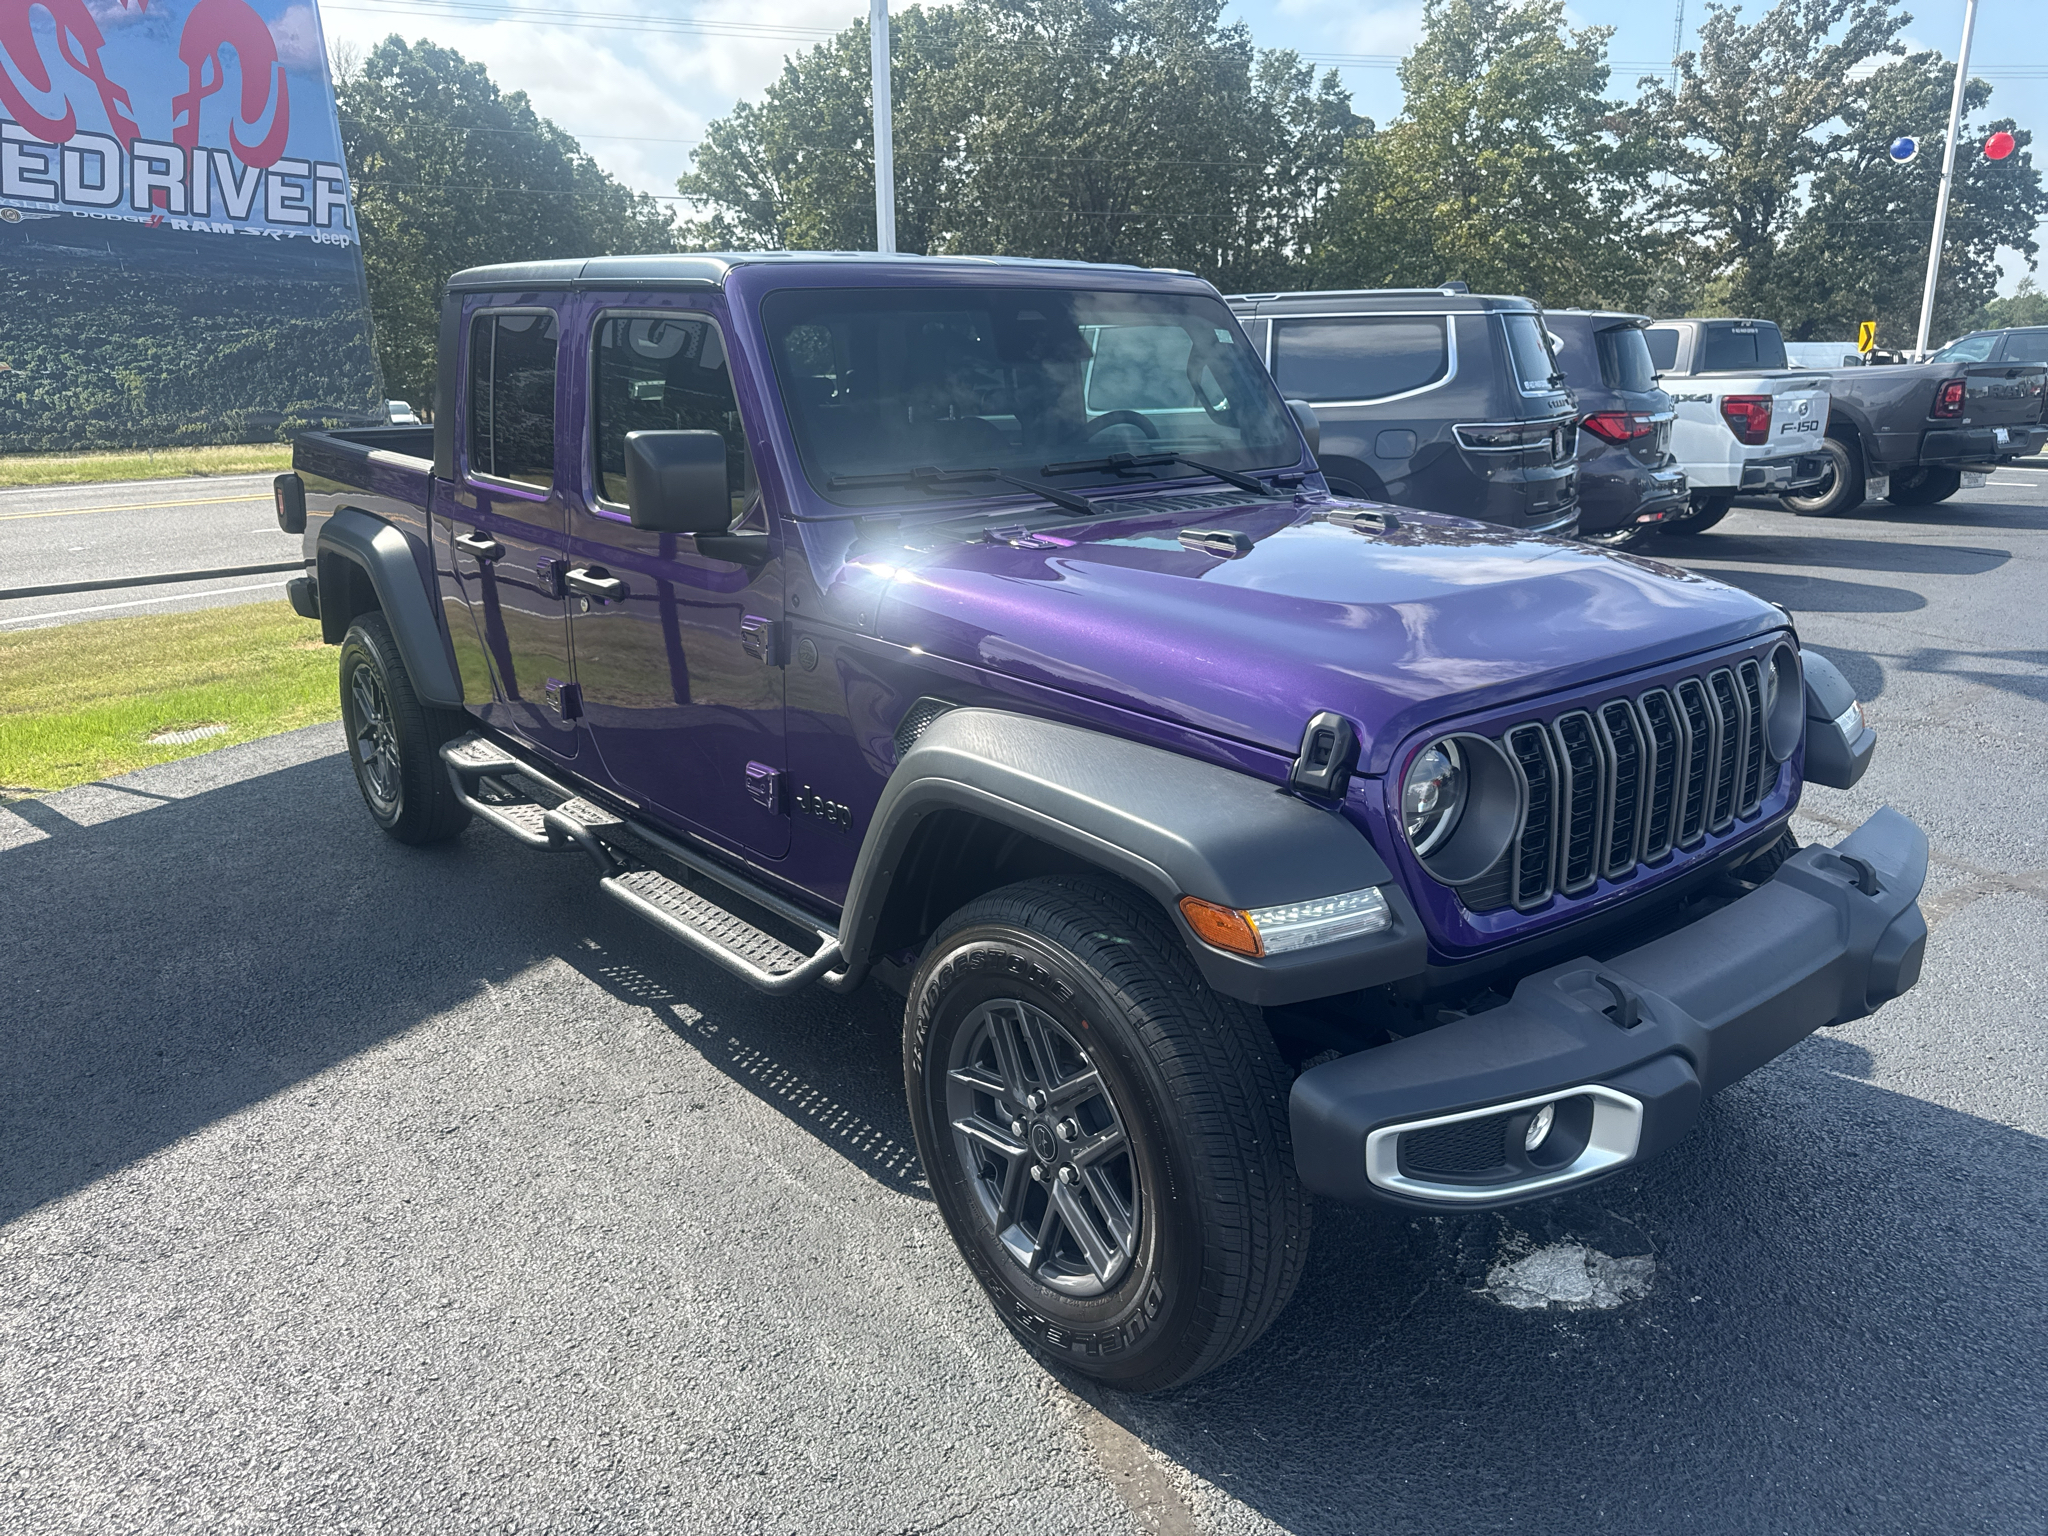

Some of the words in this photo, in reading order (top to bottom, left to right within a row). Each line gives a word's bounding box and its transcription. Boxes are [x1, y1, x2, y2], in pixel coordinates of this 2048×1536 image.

[72, 210, 154, 224] DODGE
[170, 218, 235, 235] RAM
[240, 227, 303, 241] SRT
[311, 228, 350, 249] Jeep
[1780, 420, 1819, 435] F-150
[796, 784, 853, 834] Jeep
[912, 948, 1075, 1077] BRIDGESTONE
[1014, 1277, 1164, 1356] DUELER
